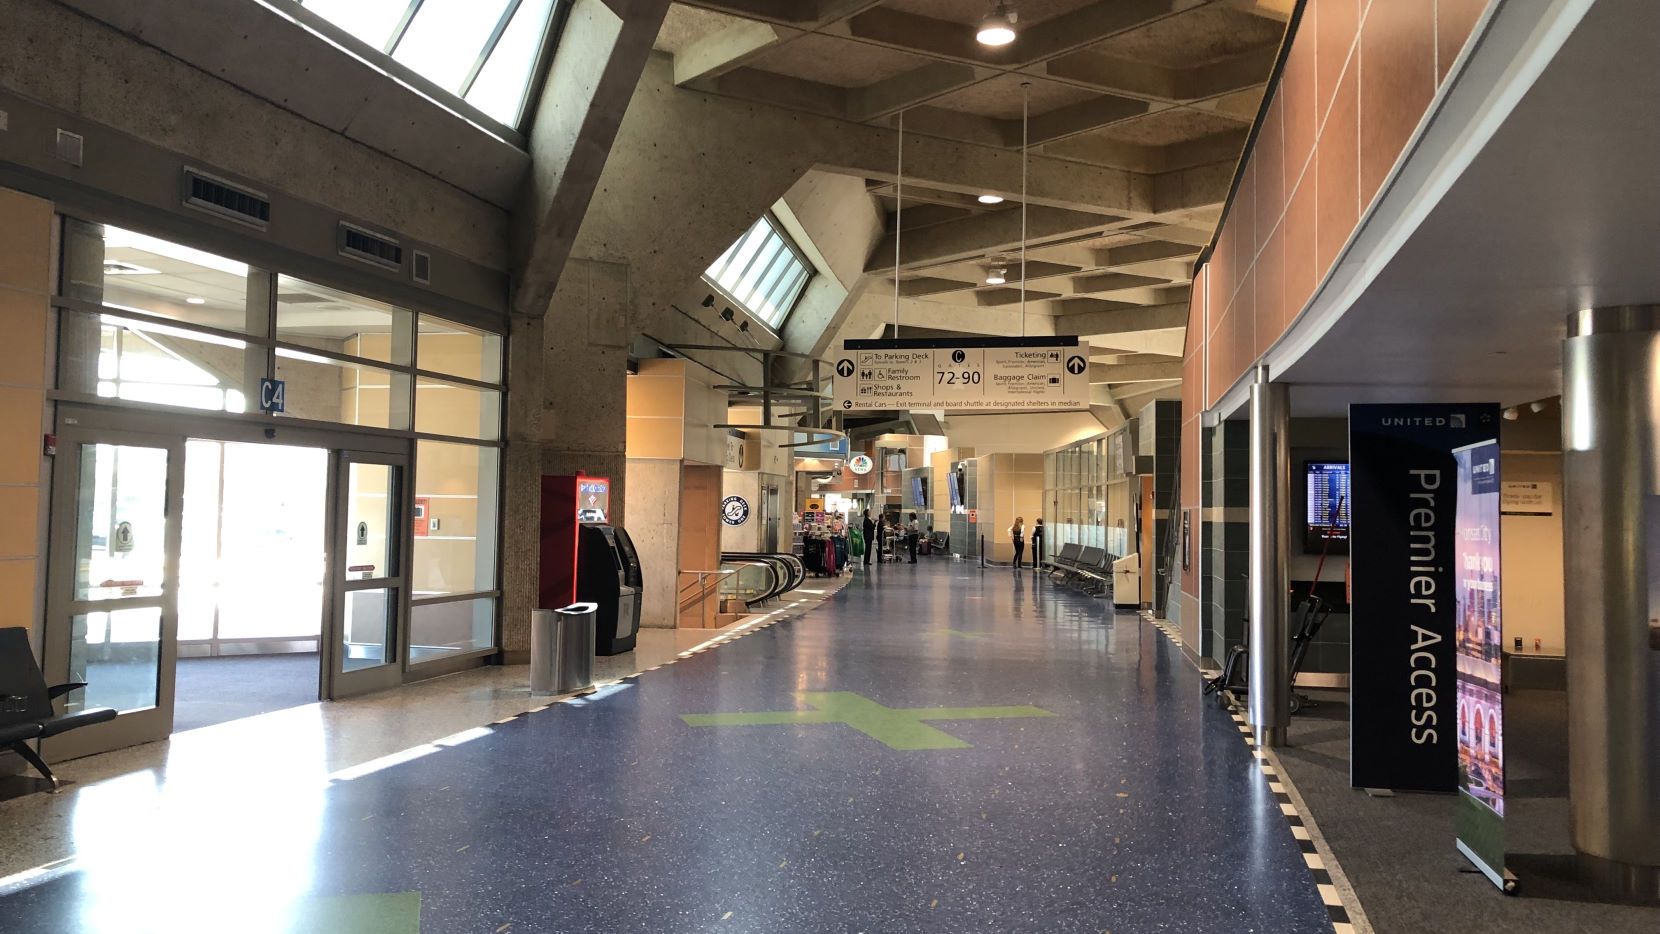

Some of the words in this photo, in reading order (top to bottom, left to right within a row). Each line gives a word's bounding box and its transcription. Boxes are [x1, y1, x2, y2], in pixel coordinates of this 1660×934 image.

[884, 353, 909, 362] Parking
[912, 352, 929, 360] Deck
[1015, 351, 1047, 360] Ticketing
[936, 371, 981, 385] 72-90
[993, 374, 1025, 382] Baggage
[1027, 373, 1047, 381] Claim
[873, 384, 894, 392] Shops
[261, 381, 283, 410] C4
[873, 390, 913, 398] Restaurants
[992, 400, 1025, 408] designated
[1382, 417, 1446, 426] UNITED
[1409, 469, 1443, 613] Premier
[1410, 624, 1442, 744] Access
